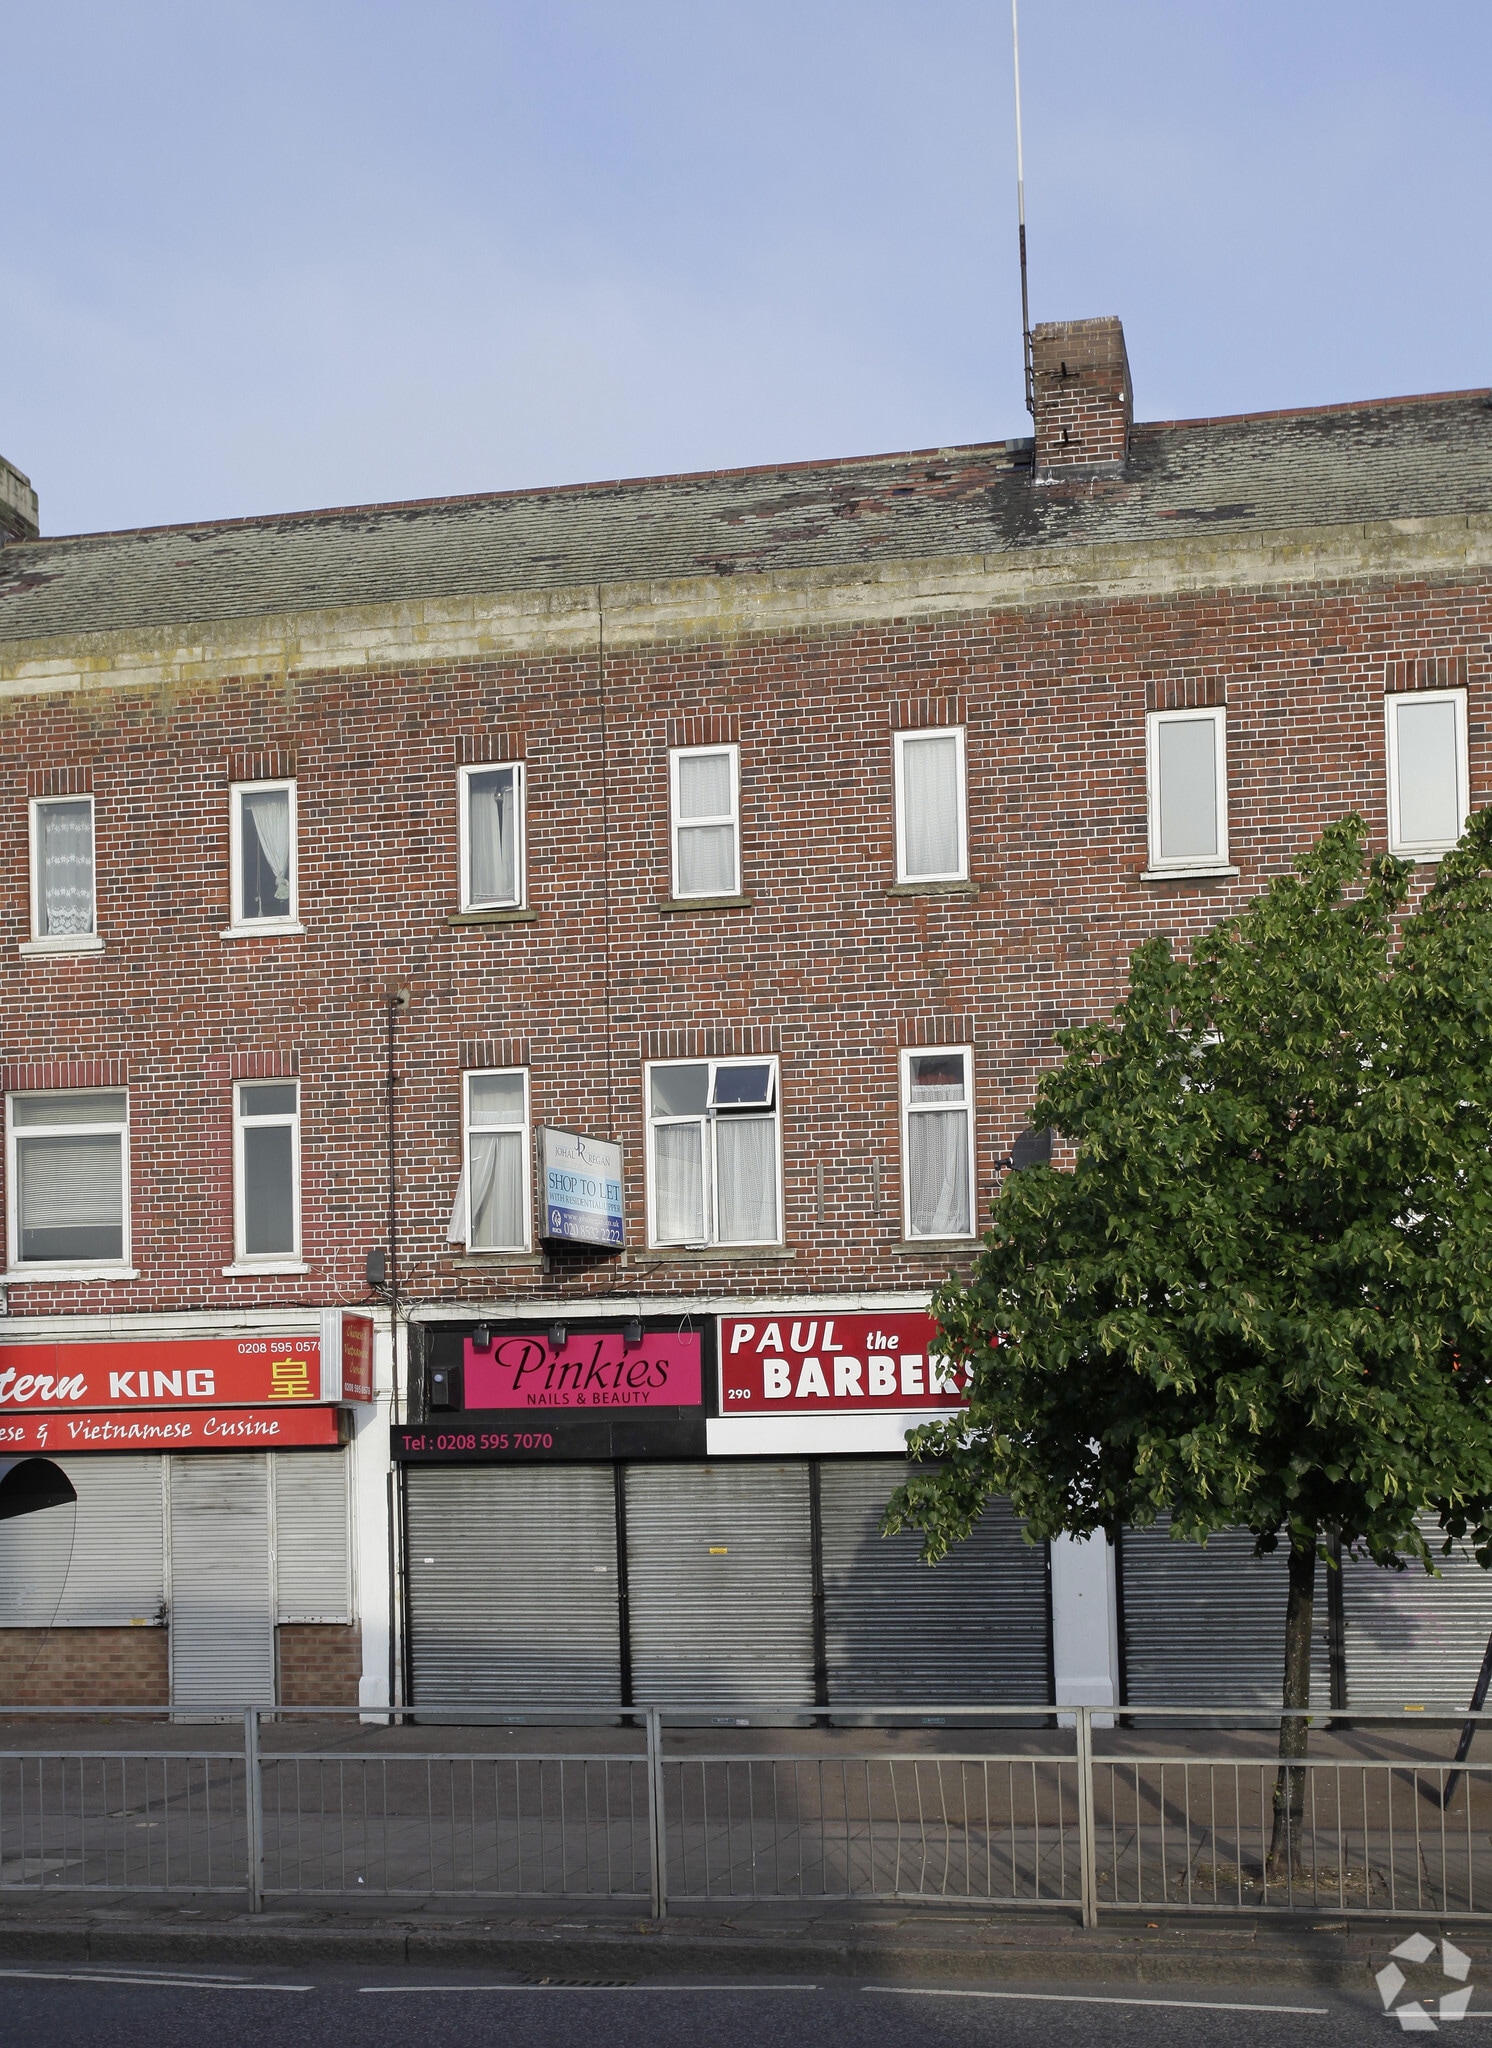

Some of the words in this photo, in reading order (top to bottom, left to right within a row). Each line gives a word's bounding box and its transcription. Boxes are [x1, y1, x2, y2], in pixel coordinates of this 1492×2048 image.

[555, 1147, 575, 1159] JOHAL
[589, 1155, 610, 1166] REGAN
[549, 1172, 577, 1192] SHOP
[580, 1179, 596, 1196] TO
[600, 1183, 619, 1201] LET
[549, 1192, 565, 1202] WITH
[566, 1195, 602, 1210] RESIDENTIAL
[603, 1201, 620, 1212] UPPER
[564, 1222, 578, 1237] 020
[580, 1225, 599, 1240] 8532
[601, 1228, 620, 1243] 2222
[238, 1343, 266, 1354] 0208
[270, 1342, 292, 1353] 595
[730, 1321, 843, 1354] PAUL
[866, 1330, 899, 1350] the
[494, 1338, 669, 1390] Pinkies
[109, 1369, 215, 1398] KING
[268, 1357, 314, 1398] 皇
[527, 1393, 569, 1405] NAILS
[576, 1393, 586, 1404] &
[593, 1392, 650, 1404] BEAUTY
[728, 1389, 751, 1399] 290
[36, 1423, 48, 1447] &
[67, 1419, 192, 1440] Vietnamese
[203, 1415, 280, 1436] Cusine
[402, 1435, 425, 1450] Tel
[437, 1434, 476, 1450] 0208
[480, 1434, 509, 1449] 595
[513, 1433, 553, 1449] 7070
